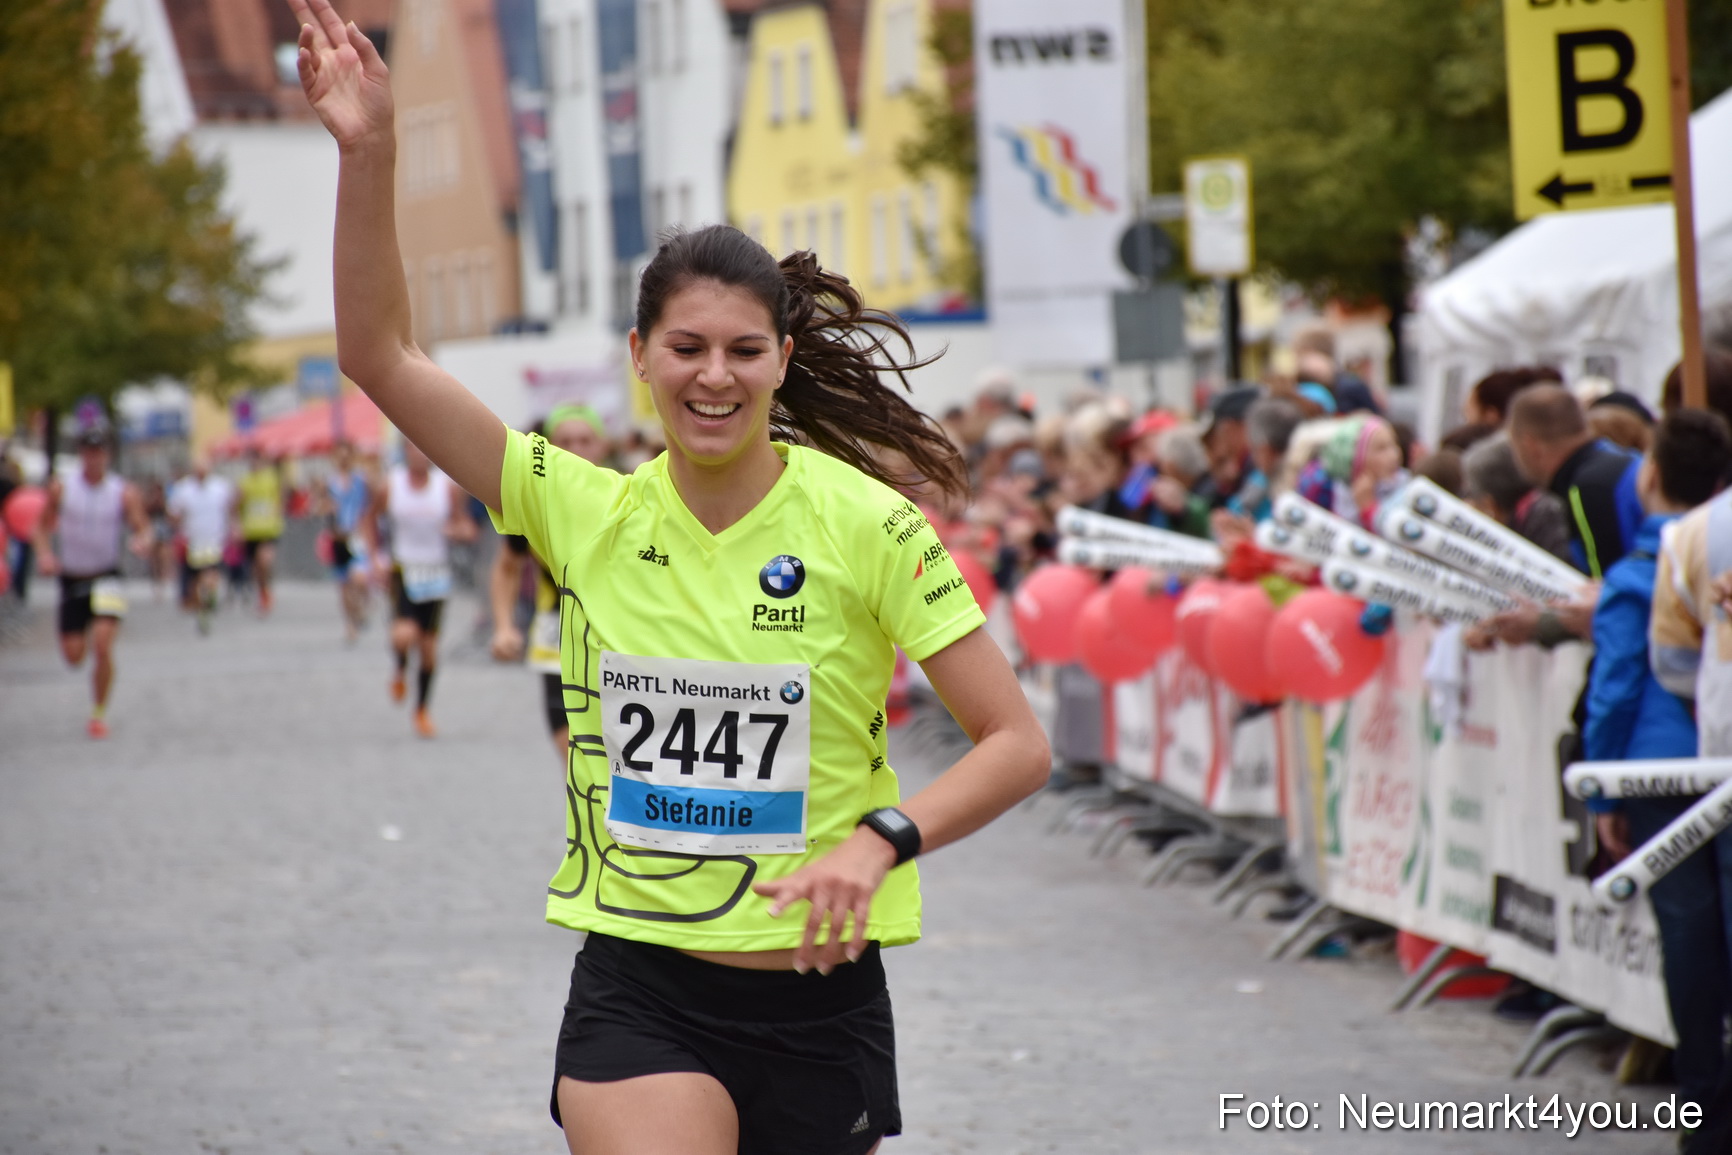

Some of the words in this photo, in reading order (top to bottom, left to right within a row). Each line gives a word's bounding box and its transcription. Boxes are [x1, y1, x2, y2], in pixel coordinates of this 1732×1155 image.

[1557, 29, 1644, 153] B
[923, 543, 947, 565] ABR
[924, 582, 952, 606] BMW
[752, 603, 806, 623] Partl
[752, 622, 804, 633] Neumarkt
[603, 670, 667, 694] PARTL
[672, 678, 771, 701] Neumarkt
[620, 703, 789, 780] 2447
[615, 762, 622, 774] A
[1620, 776, 1684, 798] BMW
[645, 793, 753, 828] Stefanie
[1642, 823, 1704, 876] BMW
